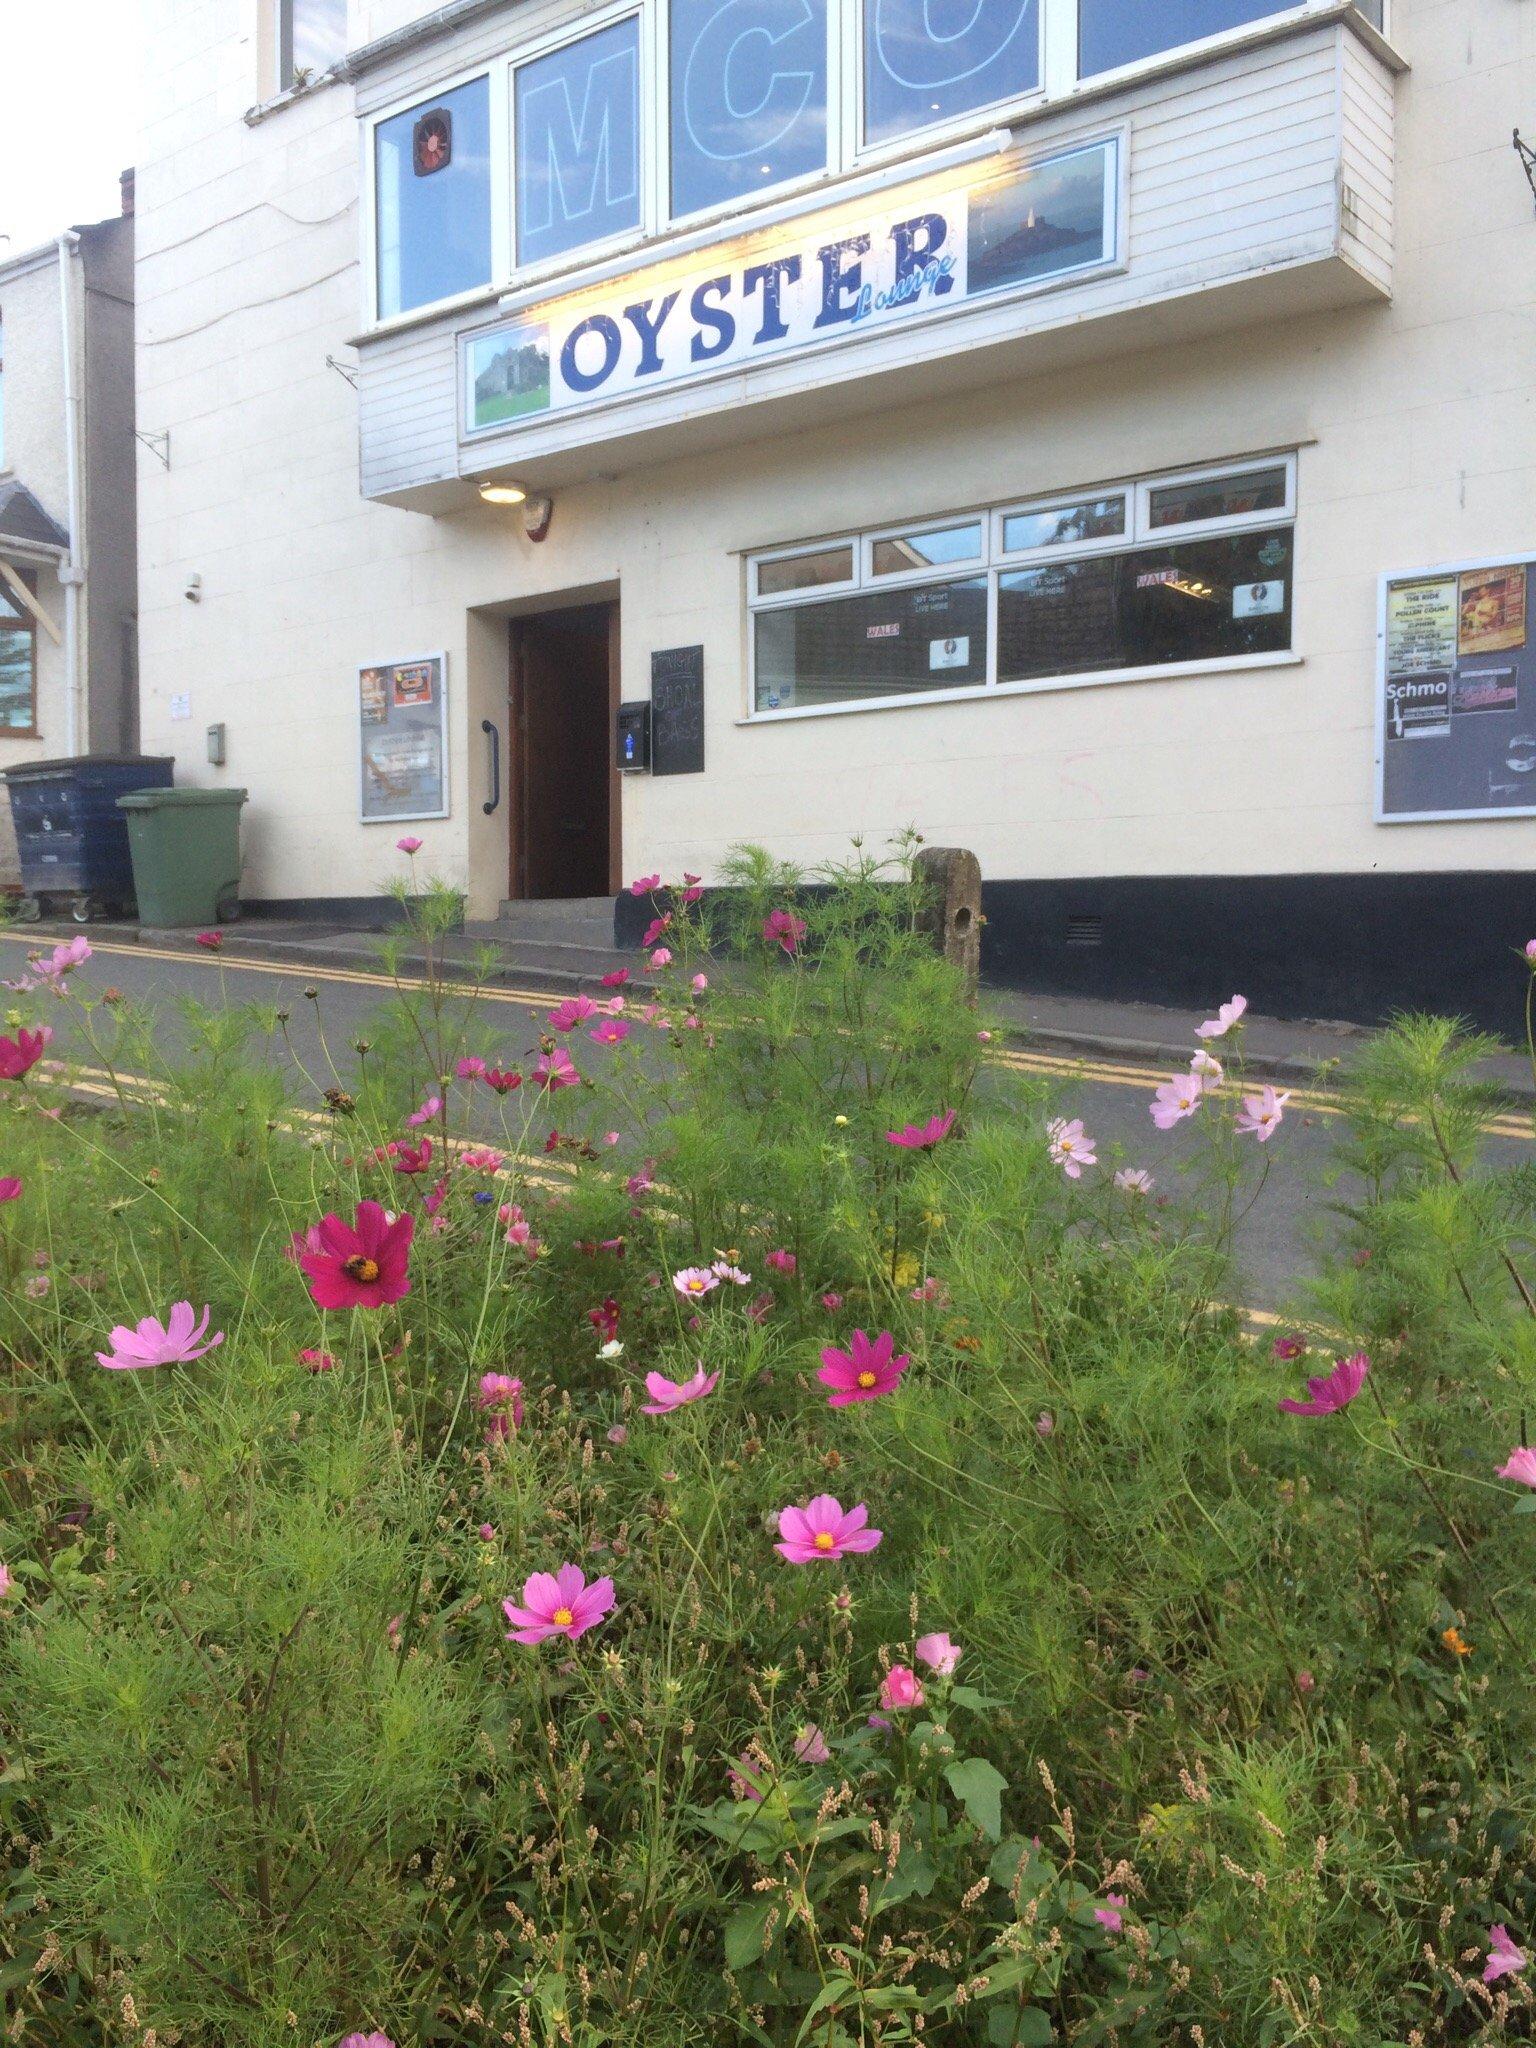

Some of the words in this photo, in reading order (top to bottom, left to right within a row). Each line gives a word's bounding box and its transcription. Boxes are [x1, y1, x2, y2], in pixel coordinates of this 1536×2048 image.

[559, 211, 957, 393] OYSTER
[850, 255, 957, 323] Lounge
[867, 623, 899, 638] WALES
[1387, 682, 1448, 699] Schmo
